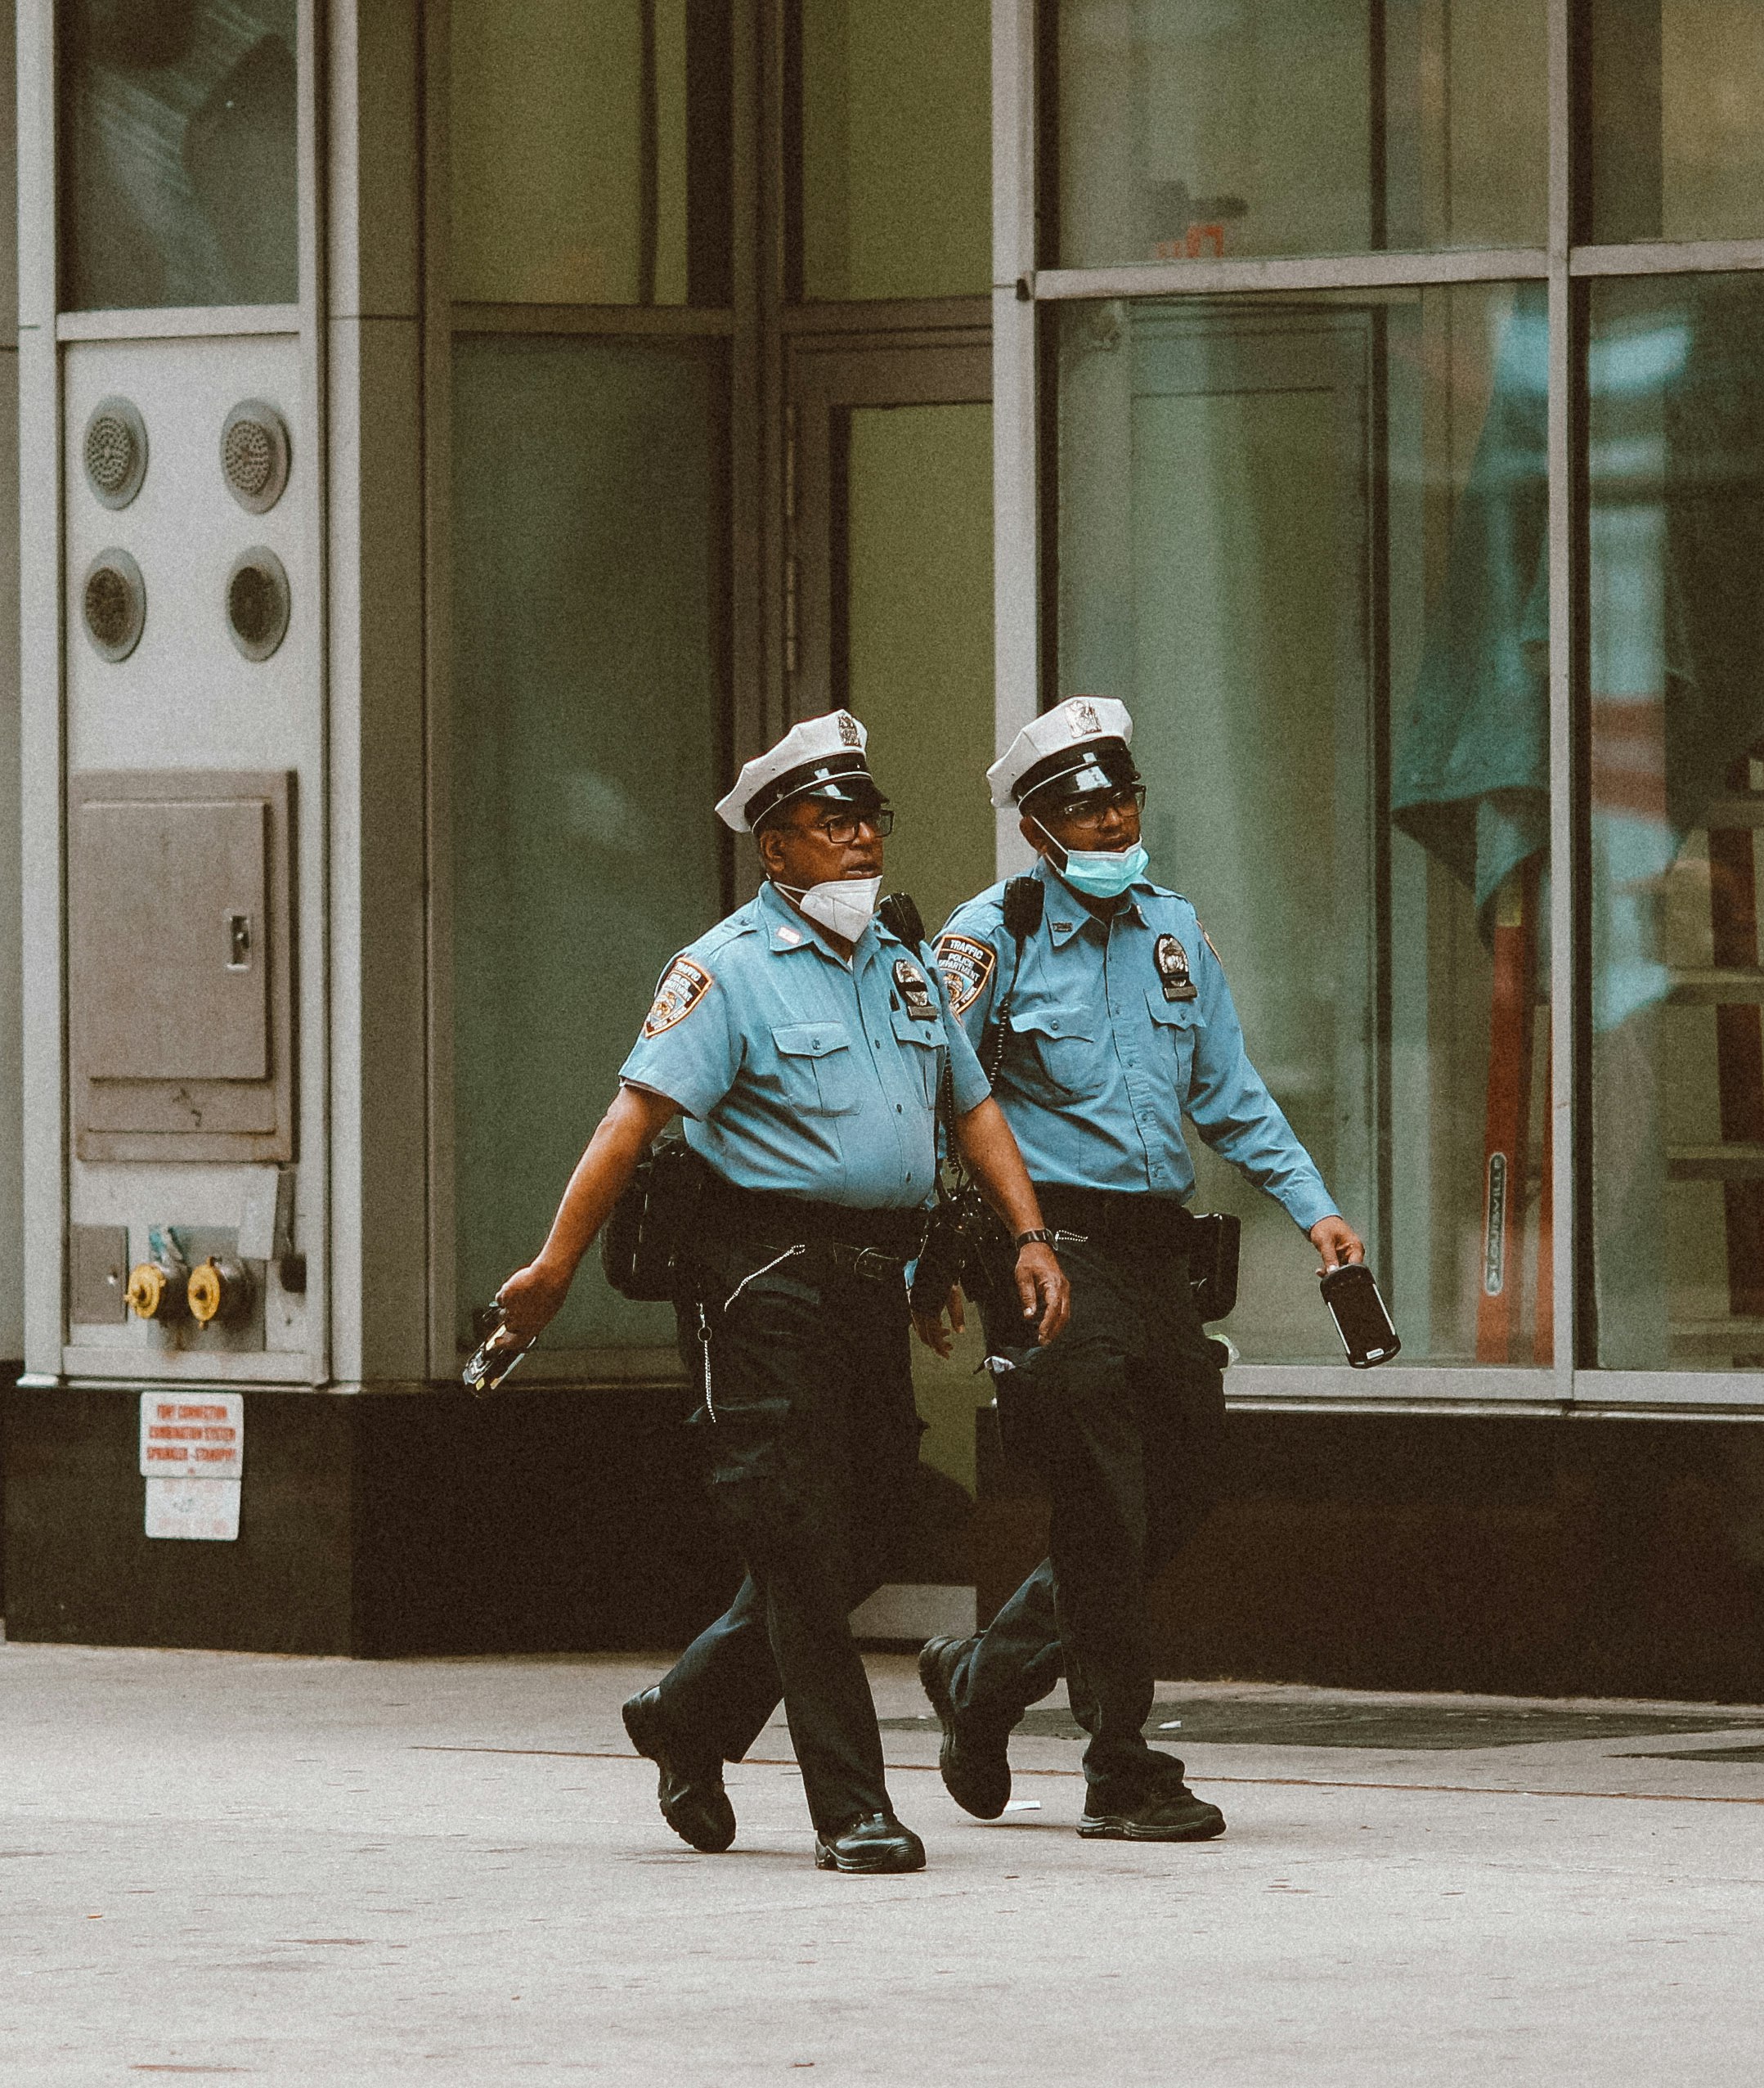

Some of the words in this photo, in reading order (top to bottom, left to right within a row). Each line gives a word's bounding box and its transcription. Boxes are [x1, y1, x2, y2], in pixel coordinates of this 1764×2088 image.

[950, 940, 984, 959] TRAFFIC
[949, 953, 975, 969] POLICE
[675, 961, 702, 981] TRAFFIC
[1489, 1158, 1501, 1270] LOUISVILLE
